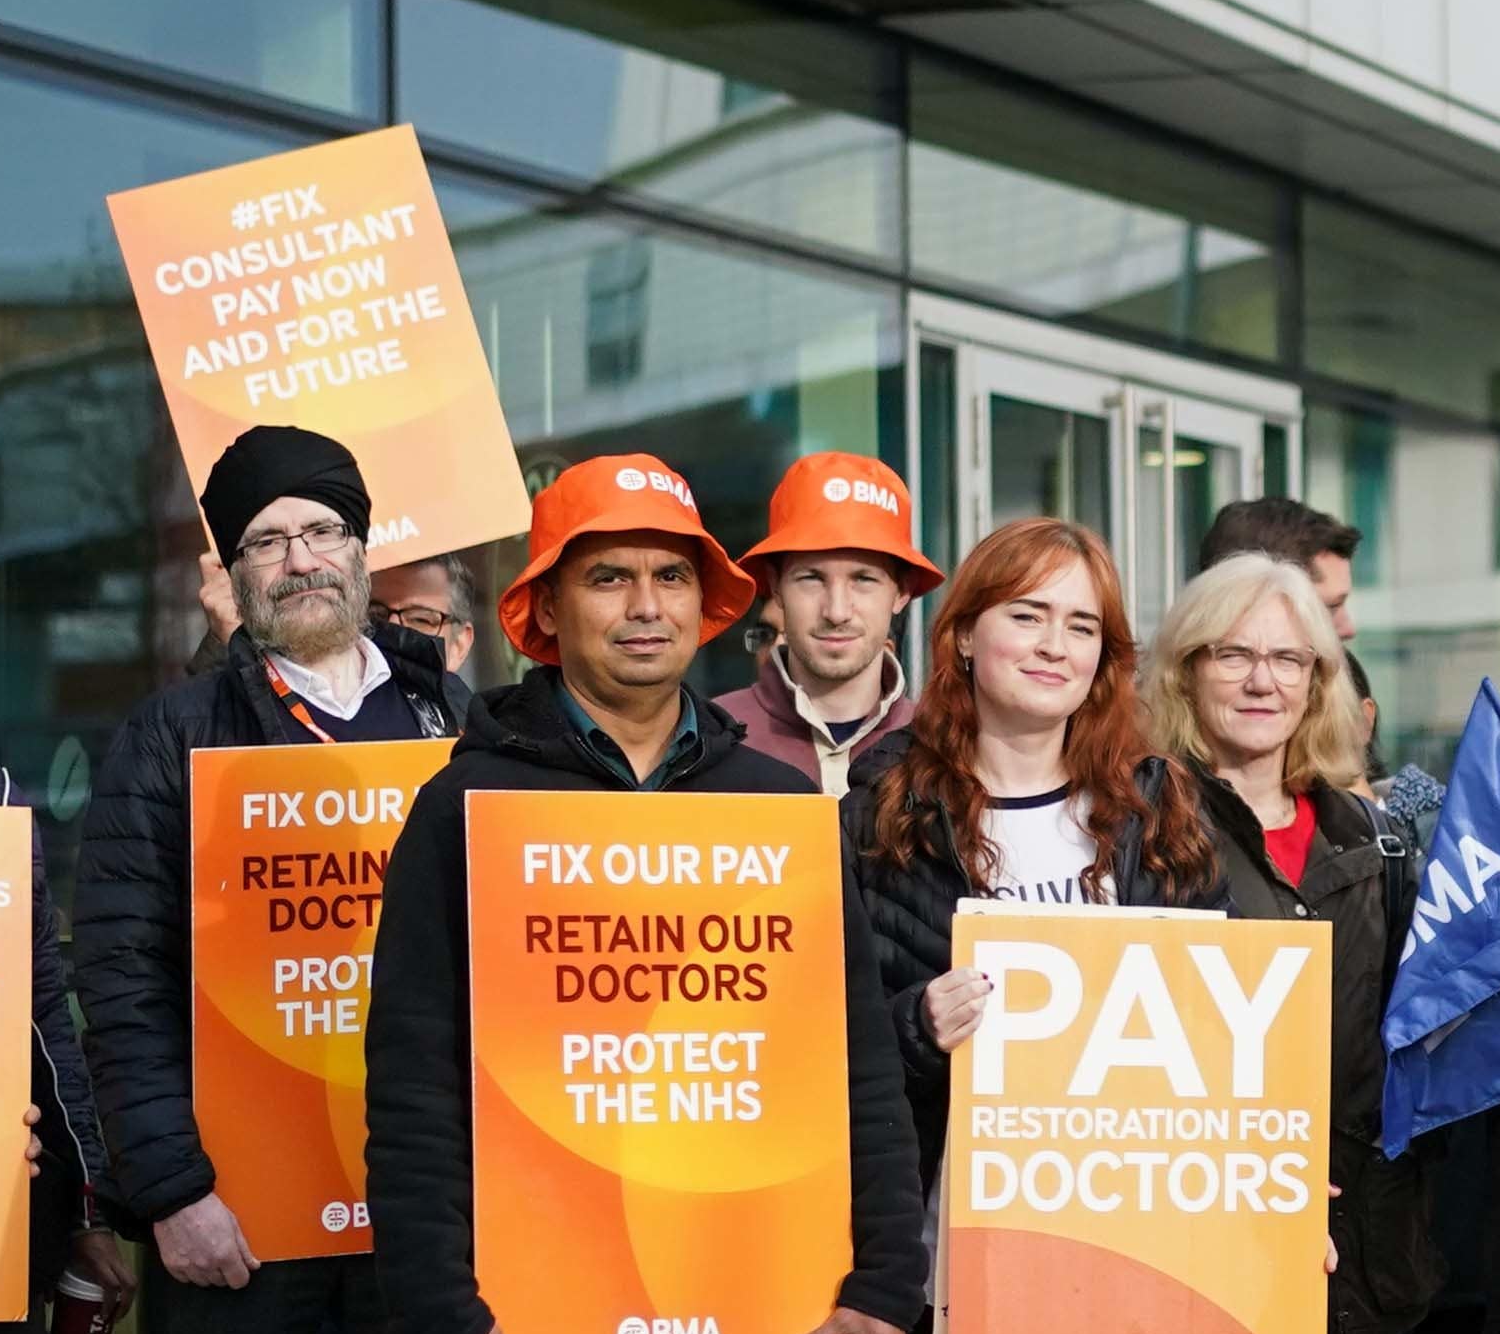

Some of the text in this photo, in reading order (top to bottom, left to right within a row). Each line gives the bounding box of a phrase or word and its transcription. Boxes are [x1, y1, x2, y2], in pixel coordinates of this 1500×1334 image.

[231, 184, 325, 231] #FIX
[155, 203, 416, 295] CONSULTANT
[211, 254, 386, 326] PAY NOW
[184, 284, 447, 379] AND FOR THE
[244, 338, 409, 407] FUTURE
[647, 471, 698, 513] BMA
[852, 480, 899, 516] BMA
[243, 787, 405, 829] FIX OUR
[242, 850, 384, 891] RETAIN
[523, 843, 790, 885] FIX OUR PAY
[525, 914, 793, 954] RETAIN OUR
[555, 963, 768, 1004] DOCTORS
[276, 997, 361, 1037] THE
[972, 939, 1312, 1099] PAY
[562, 1031, 766, 1075] PROTECT
[565, 1079, 762, 1124] THE NHS
[971, 1105, 1311, 1142] RESTORATION FOR
[971, 1149, 1309, 1214] DOCTORS
